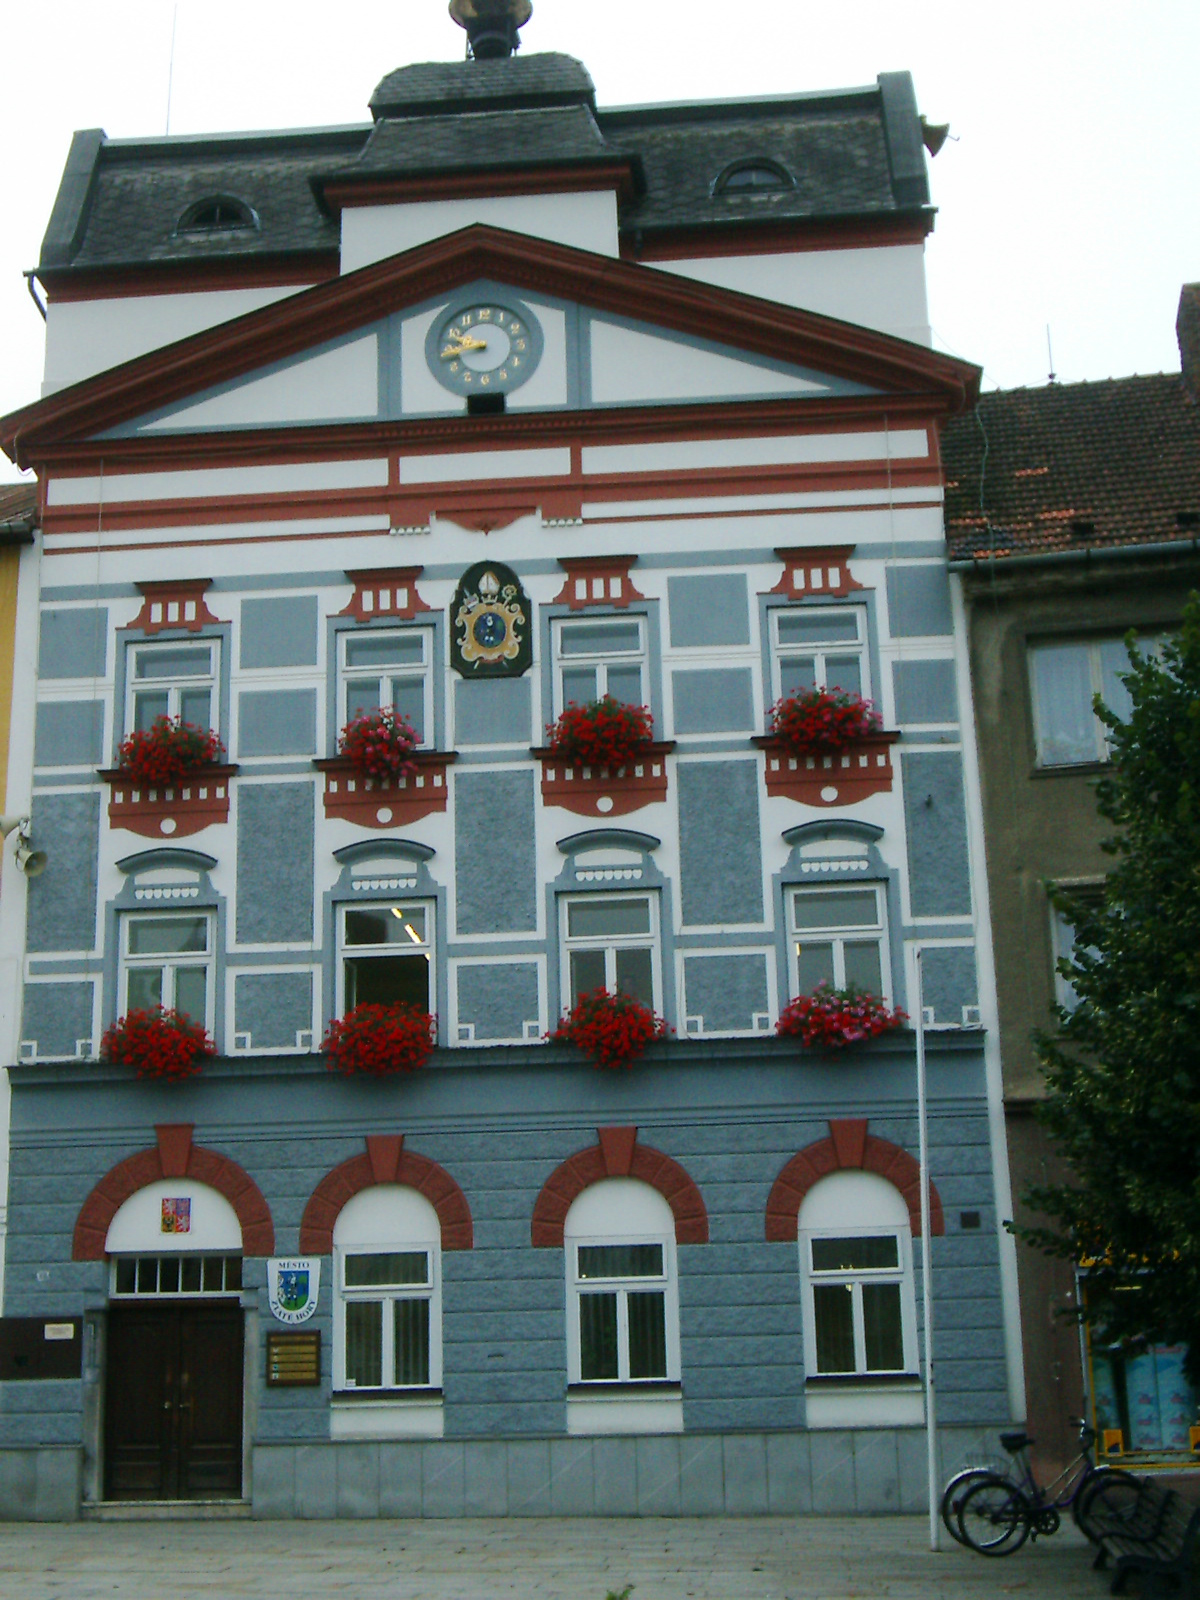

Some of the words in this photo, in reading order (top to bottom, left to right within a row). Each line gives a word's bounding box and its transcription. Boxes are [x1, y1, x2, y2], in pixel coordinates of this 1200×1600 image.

[462, 314, 471, 326] 11
[479, 309, 490, 320] 12
[448, 328, 460, 338] 10
[511, 323, 520, 334] 2
[481, 374, 490, 385] 6
[296, 1300, 316, 1320] HORY
